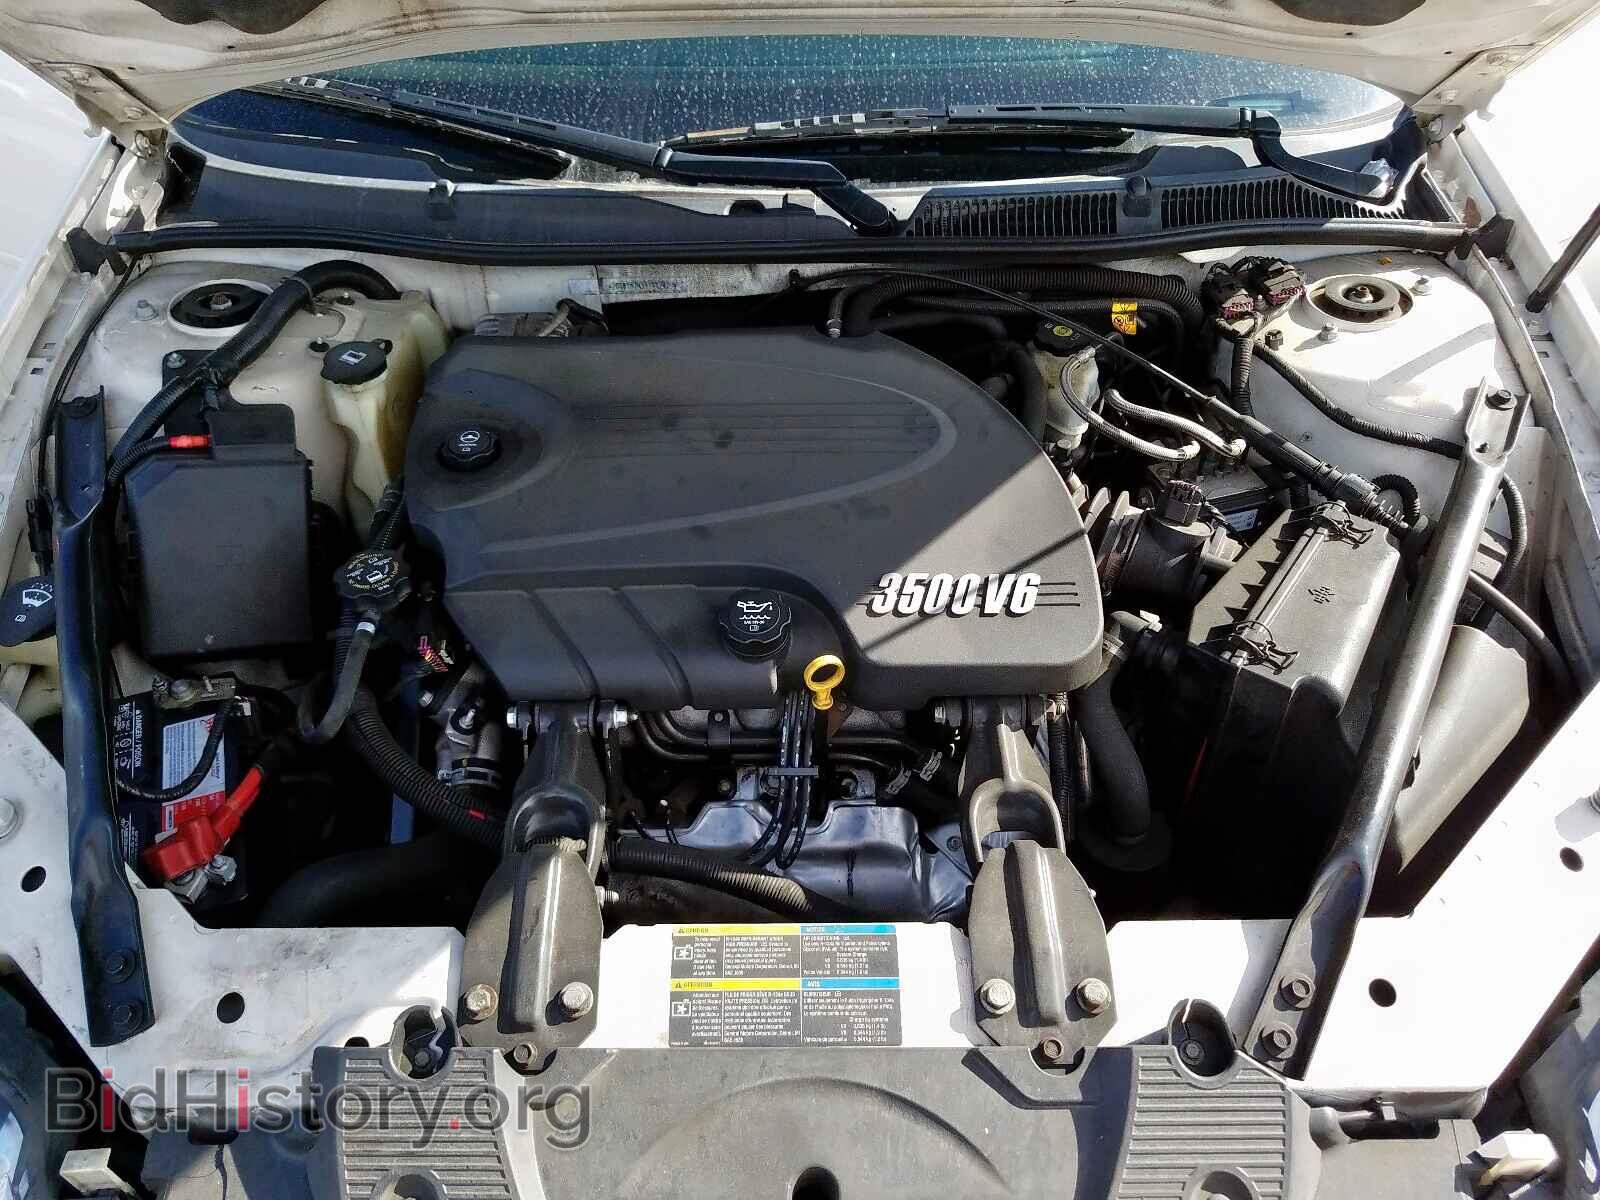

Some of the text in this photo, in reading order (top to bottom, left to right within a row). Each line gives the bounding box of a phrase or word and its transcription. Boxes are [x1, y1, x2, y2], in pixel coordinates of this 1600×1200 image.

[868, 573, 1041, 616] 3500 V6
[135, 716, 143, 740] DANGER
